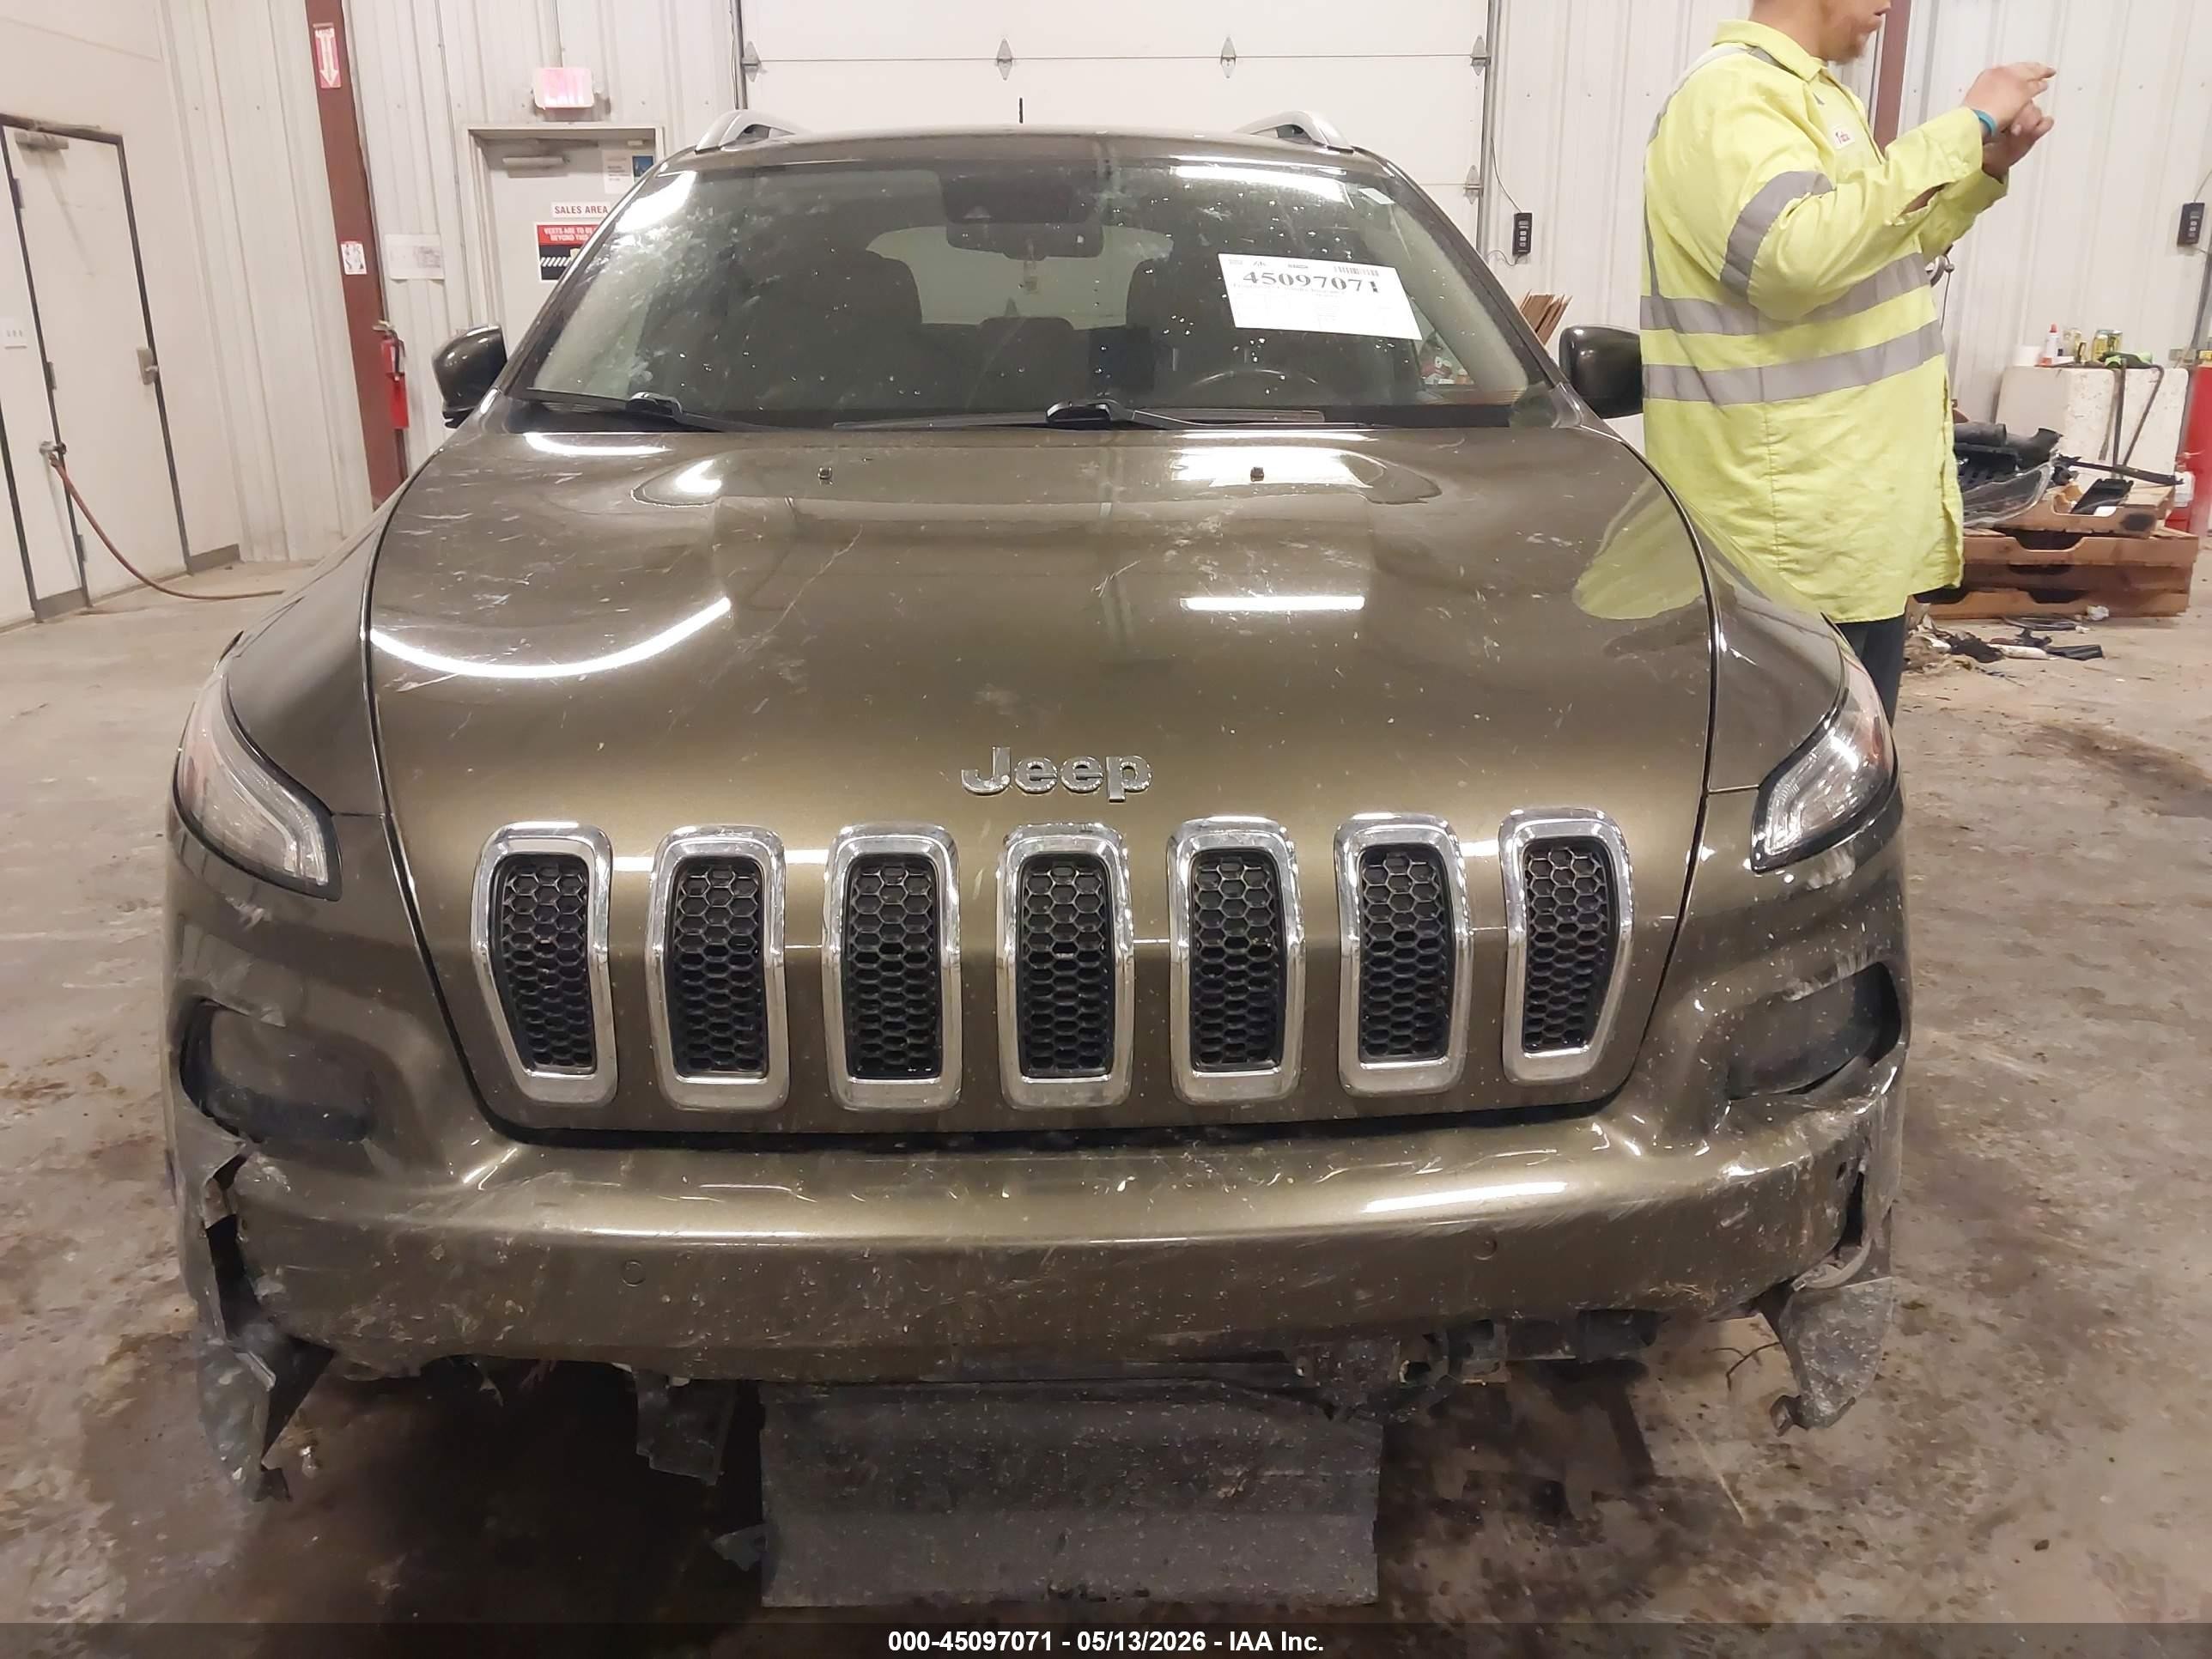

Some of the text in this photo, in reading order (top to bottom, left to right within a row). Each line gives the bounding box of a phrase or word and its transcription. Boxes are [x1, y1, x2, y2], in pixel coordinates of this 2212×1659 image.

[555, 205, 609, 214] SALES AREA
[1243, 270, 1379, 294] 45097071
[961, 745, 1153, 804] Jeep
